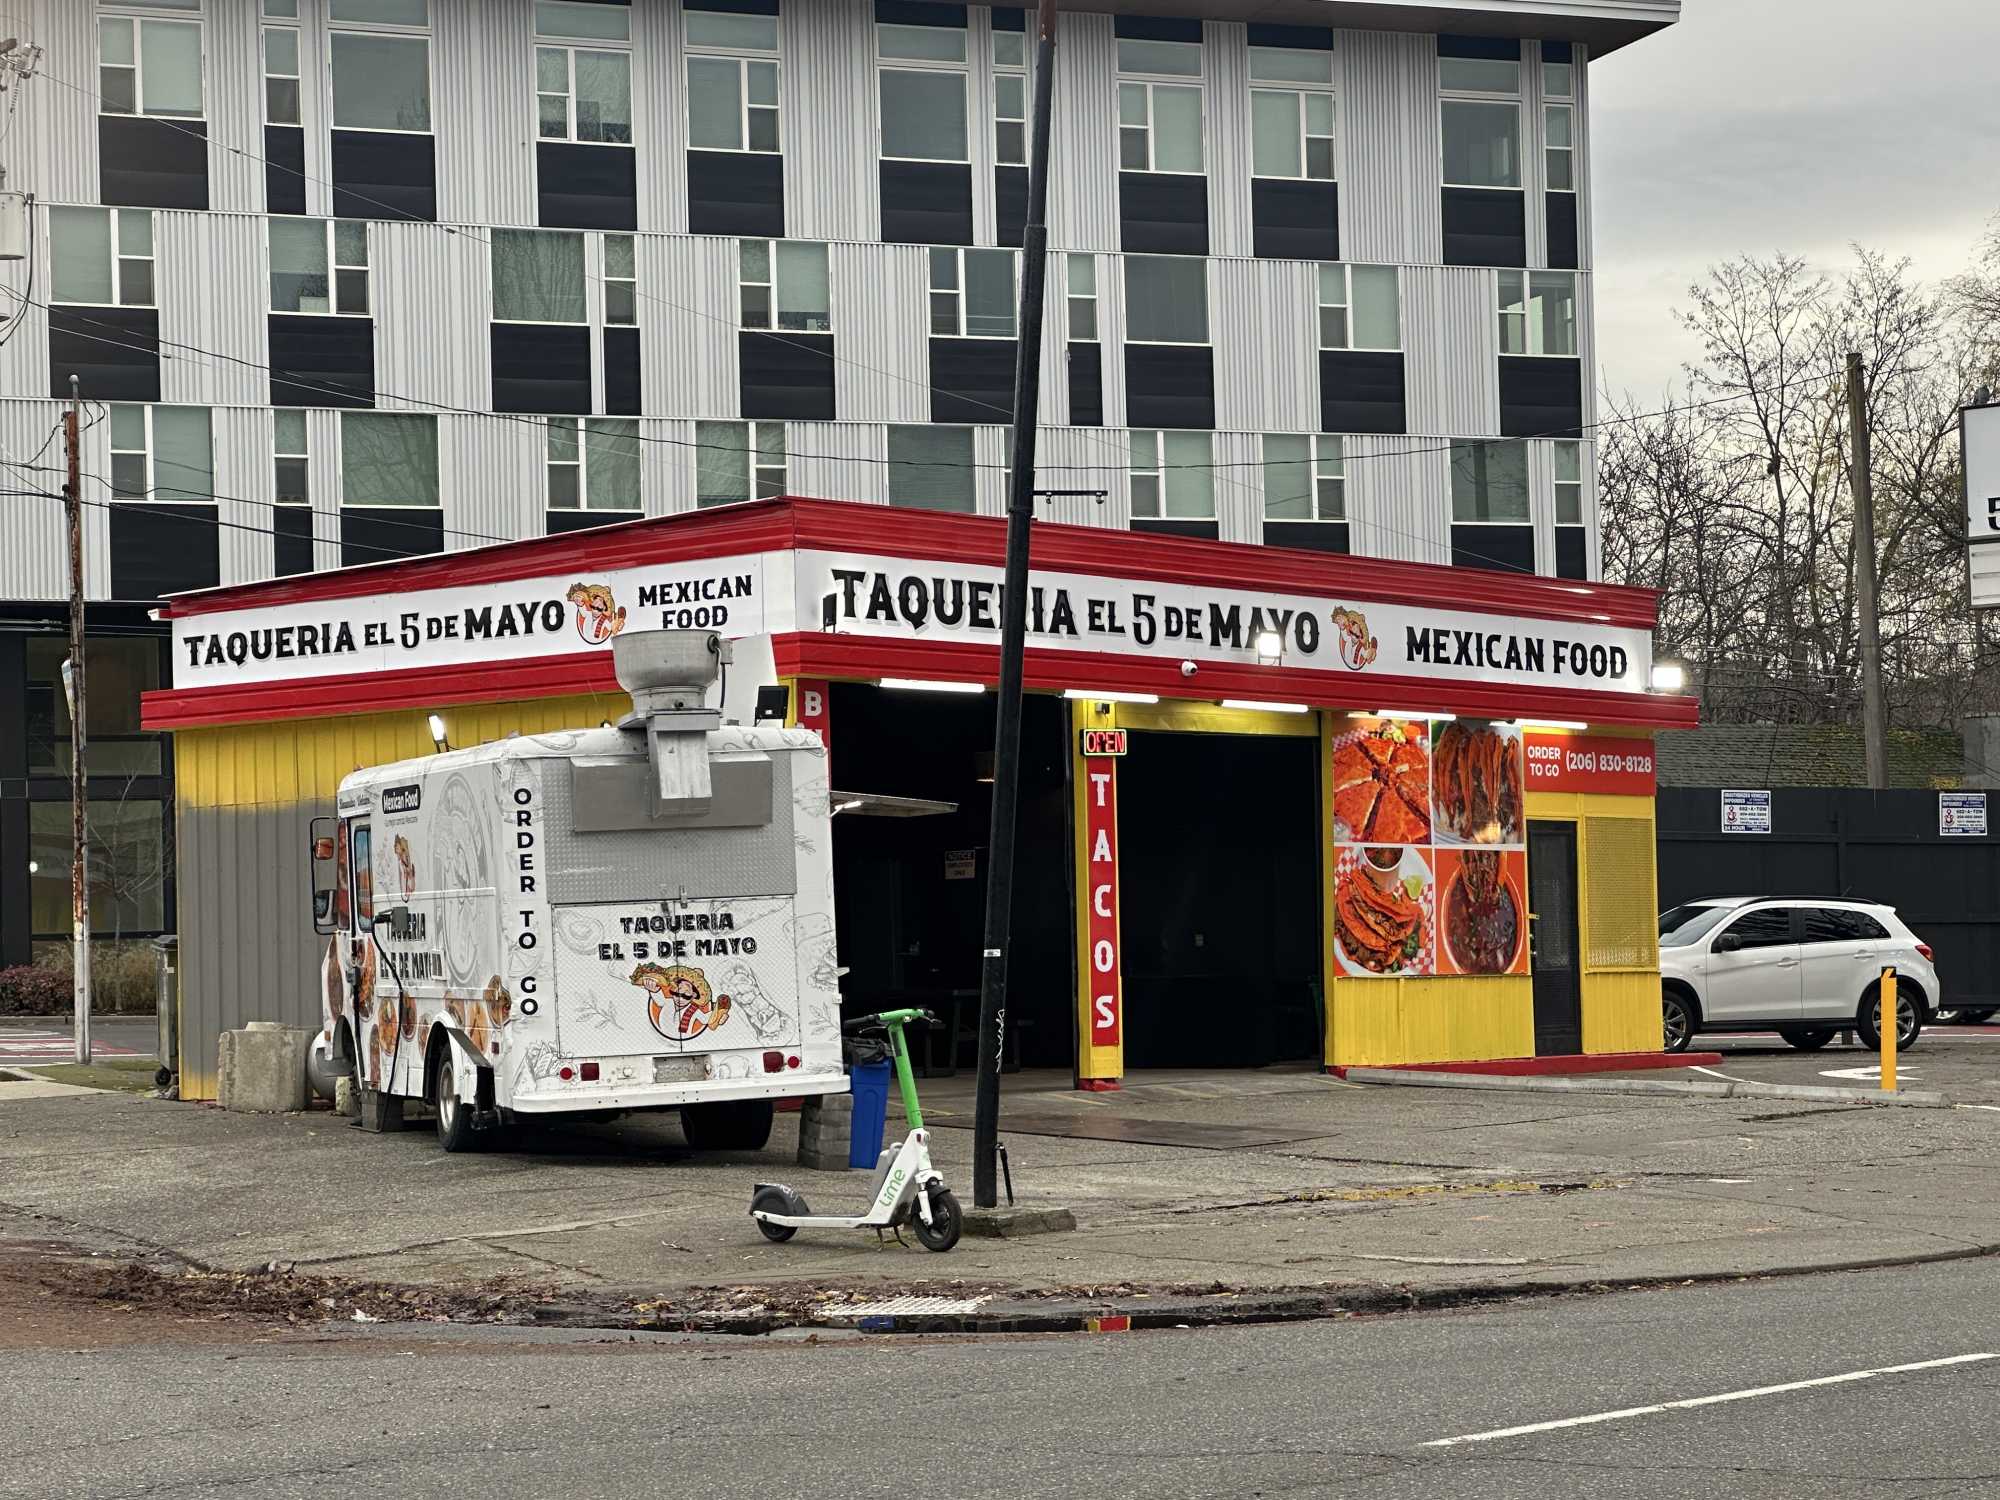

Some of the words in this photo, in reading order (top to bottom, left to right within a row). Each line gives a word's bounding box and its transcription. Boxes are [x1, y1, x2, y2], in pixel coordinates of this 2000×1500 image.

[638, 574, 753, 607] MEXICAN
[662, 605, 728, 629] FOOD
[831, 569, 1080, 636] TAQUEIA
[1087, 598, 1127, 634] EL
[1132, 593, 1157, 646] 5
[1164, 605, 1204, 640] DE
[1208, 603, 1320, 654] MAYO
[1406, 626, 1545, 673] MEXICAN
[1553, 640, 1628, 679] FOOD
[183, 621, 358, 667] TAQUERIA
[364, 622, 396, 647] EL
[400, 612, 420, 649] 5
[426, 614, 460, 640] DE
[464, 600, 565, 641] MAYO
[1086, 731, 1125, 753] OPEN
[1527, 745, 1561, 760] ORDER
[1529, 763, 1543, 777] TO
[1545, 764, 1560, 777] GO
[1565, 750, 1597, 773] (206)
[1600, 754, 1652, 773] 830-8128
[383, 791, 404, 812] Mexican
[405, 788, 419, 809] Food
[514, 787, 536, 893] ORDER
[1090, 773, 1115, 1029] TACOS
[518, 910, 537, 950] TO
[620, 912, 735, 935] TAQUERIA
[598, 943, 625, 961] EL
[633, 942, 649, 959] 5
[658, 940, 687, 958] DE
[695, 936, 758, 957] MAYO
[520, 976, 539, 1016] GO
